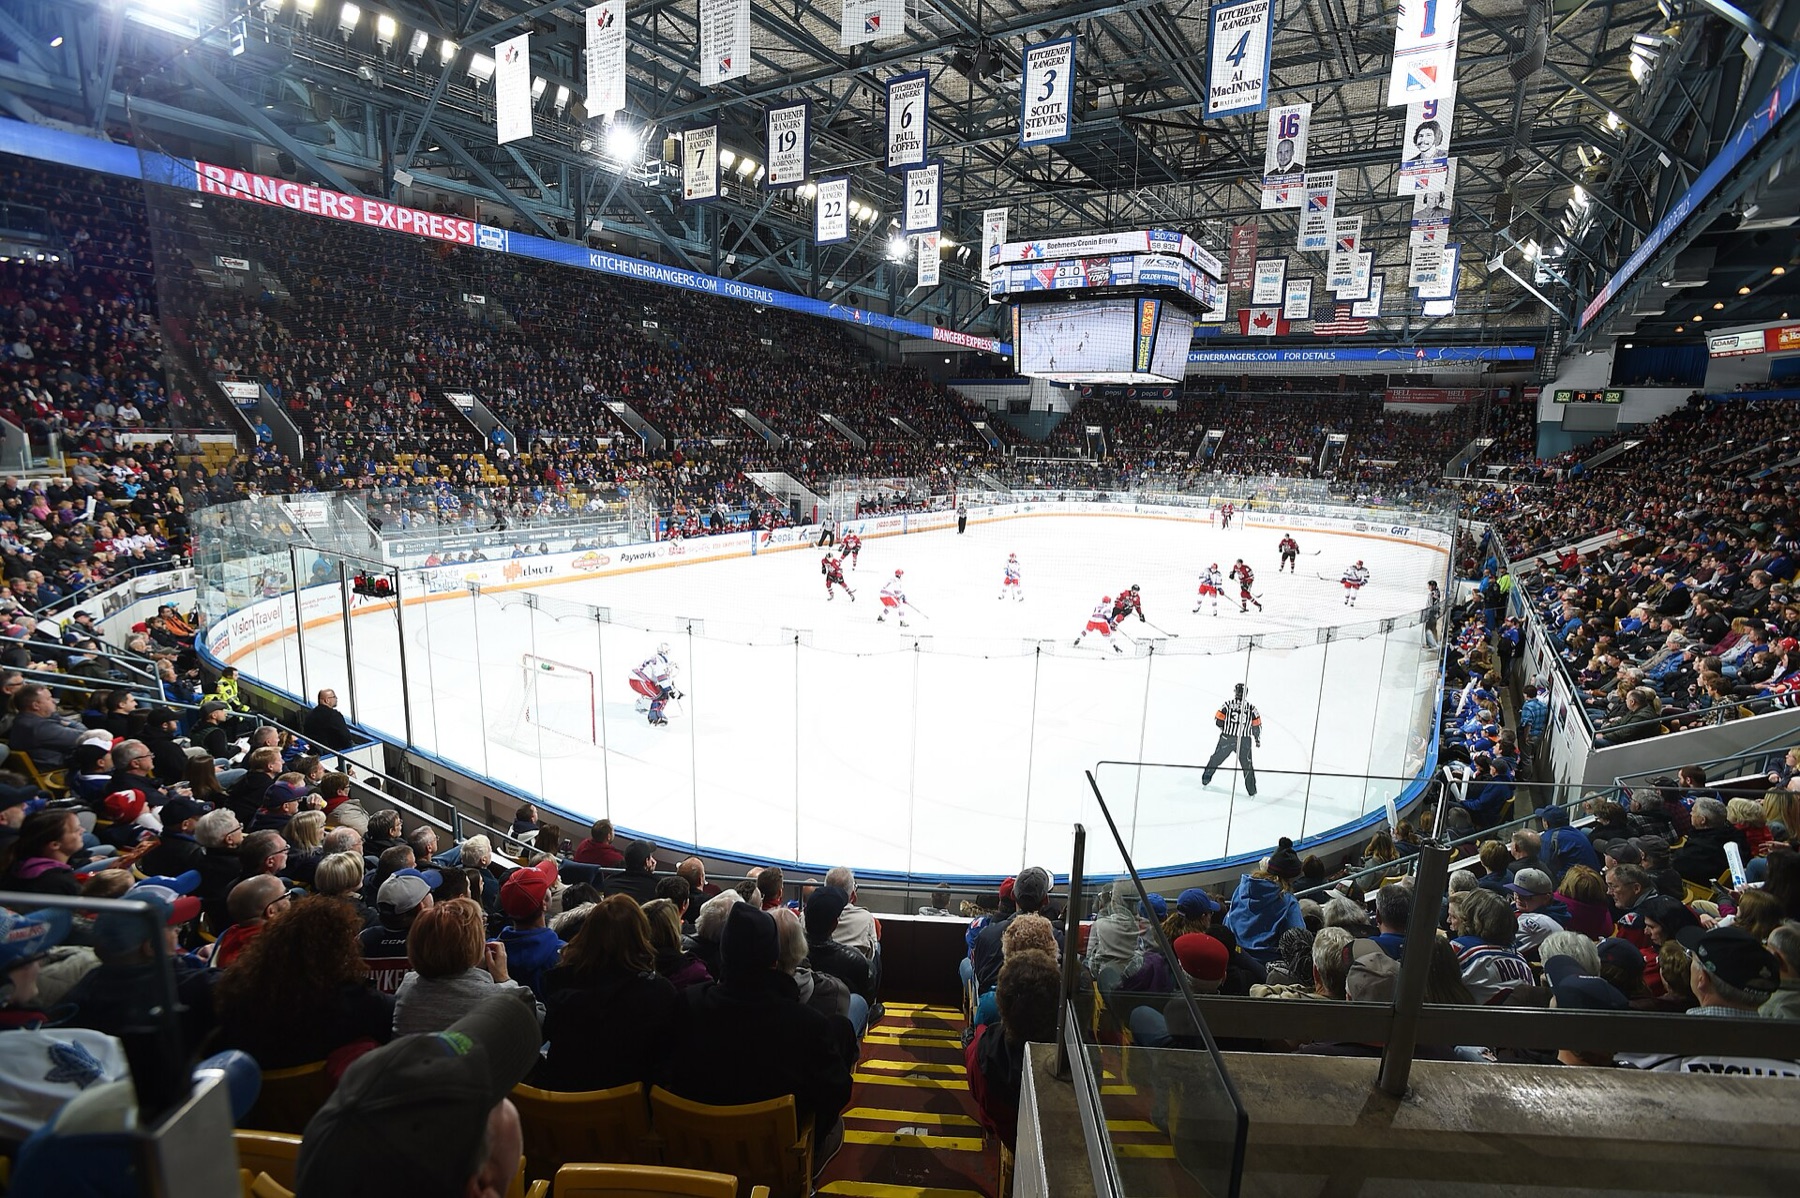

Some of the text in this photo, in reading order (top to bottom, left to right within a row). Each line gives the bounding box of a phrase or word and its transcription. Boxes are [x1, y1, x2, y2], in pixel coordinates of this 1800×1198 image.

[1217, 2, 1268, 22] KITCHENER
[1420, 0, 1437, 38] 1
[1221, 14, 1262, 31] RANGERS
[1029, 46, 1070, 61] KITCHENER
[1225, 30, 1251, 67] 4
[1033, 56, 1065, 70] RANGERS
[890, 81, 924, 94] KITCHENER
[1037, 69, 1057, 102] 3
[1211, 79, 1261, 98] MacINNIS
[894, 89, 921, 100] RANGERS
[771, 109, 804, 122] KITCHENER
[901, 101, 914, 129] 6
[1031, 102, 1062, 117] SCOTT
[773, 120, 801, 131] RANGERS
[1025, 113, 1066, 129] STEVENS
[1278, 114, 1300, 139] 16
[686, 129, 715, 141] KITCHENER
[778, 130, 797, 152] 19
[895, 131, 915, 142] PAUL
[689, 138, 712, 150] RANGERS
[891, 141, 921, 153] COFFEY
[696, 149, 705, 169] 7
[909, 169, 937, 179] KITCHENER
[819, 184, 845, 192] KITCHENER
[911, 177, 935, 187] RANGERS
[1307, 181, 1333, 189] RANGERS
[204, 166, 472, 243] RANGERS EXPRESS
[914, 189, 930, 206] 21
[824, 201, 841, 218] 22
[1154, 232, 1178, 241] 50/50
[590, 254, 773, 303] KITCHENERRANGERS.COM FOR DETAILS
[1059, 267, 1080, 276] 3 0
[935, 328, 991, 350] RANGERS EXPRESS
[1187, 352, 1277, 360] TCHENERRANGERS.COM
[1302, 352, 1335, 360] DETAILS
[1260, 516, 1276, 524] Life
[1391, 526, 1409, 536] GRT
[620, 549, 656, 562] Payworks
[232, 606, 281, 637] Vision Travel
